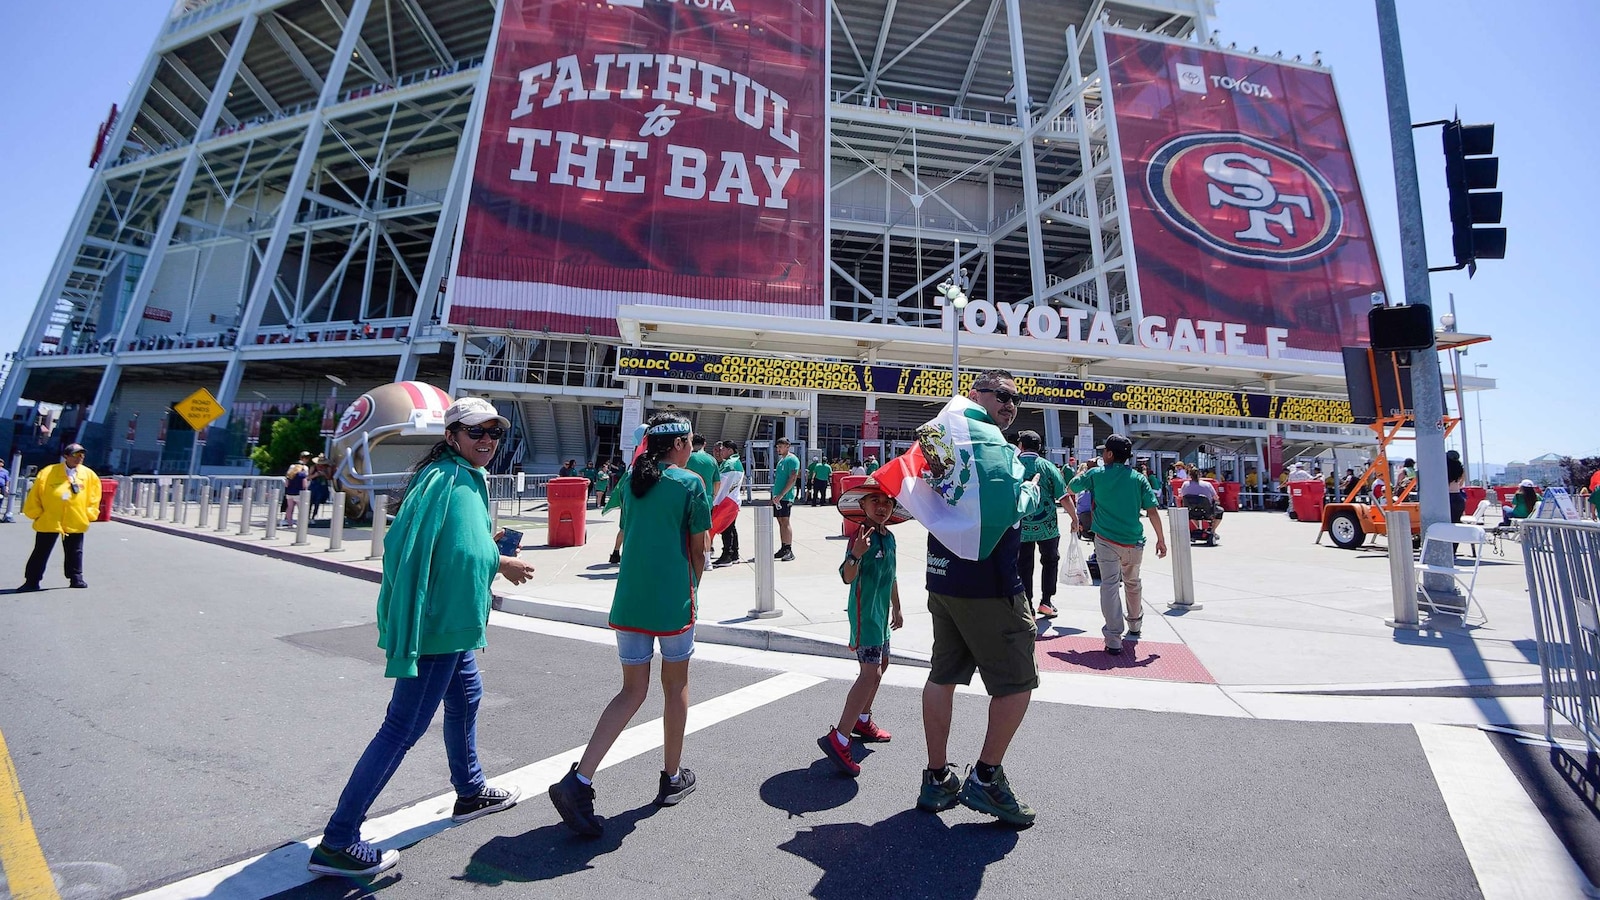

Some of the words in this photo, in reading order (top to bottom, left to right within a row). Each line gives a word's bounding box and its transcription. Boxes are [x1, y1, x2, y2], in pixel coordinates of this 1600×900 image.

[657, 0, 735, 13] OTA
[510, 53, 799, 153] FAITHFUL
[1210, 74, 1272, 99] TOYOTA
[638, 103, 681, 137] to
[506, 126, 649, 194] THE
[663, 143, 800, 209] BAY
[934, 294, 1119, 346] TOYOTA
[1138, 315, 1248, 356] GATE
